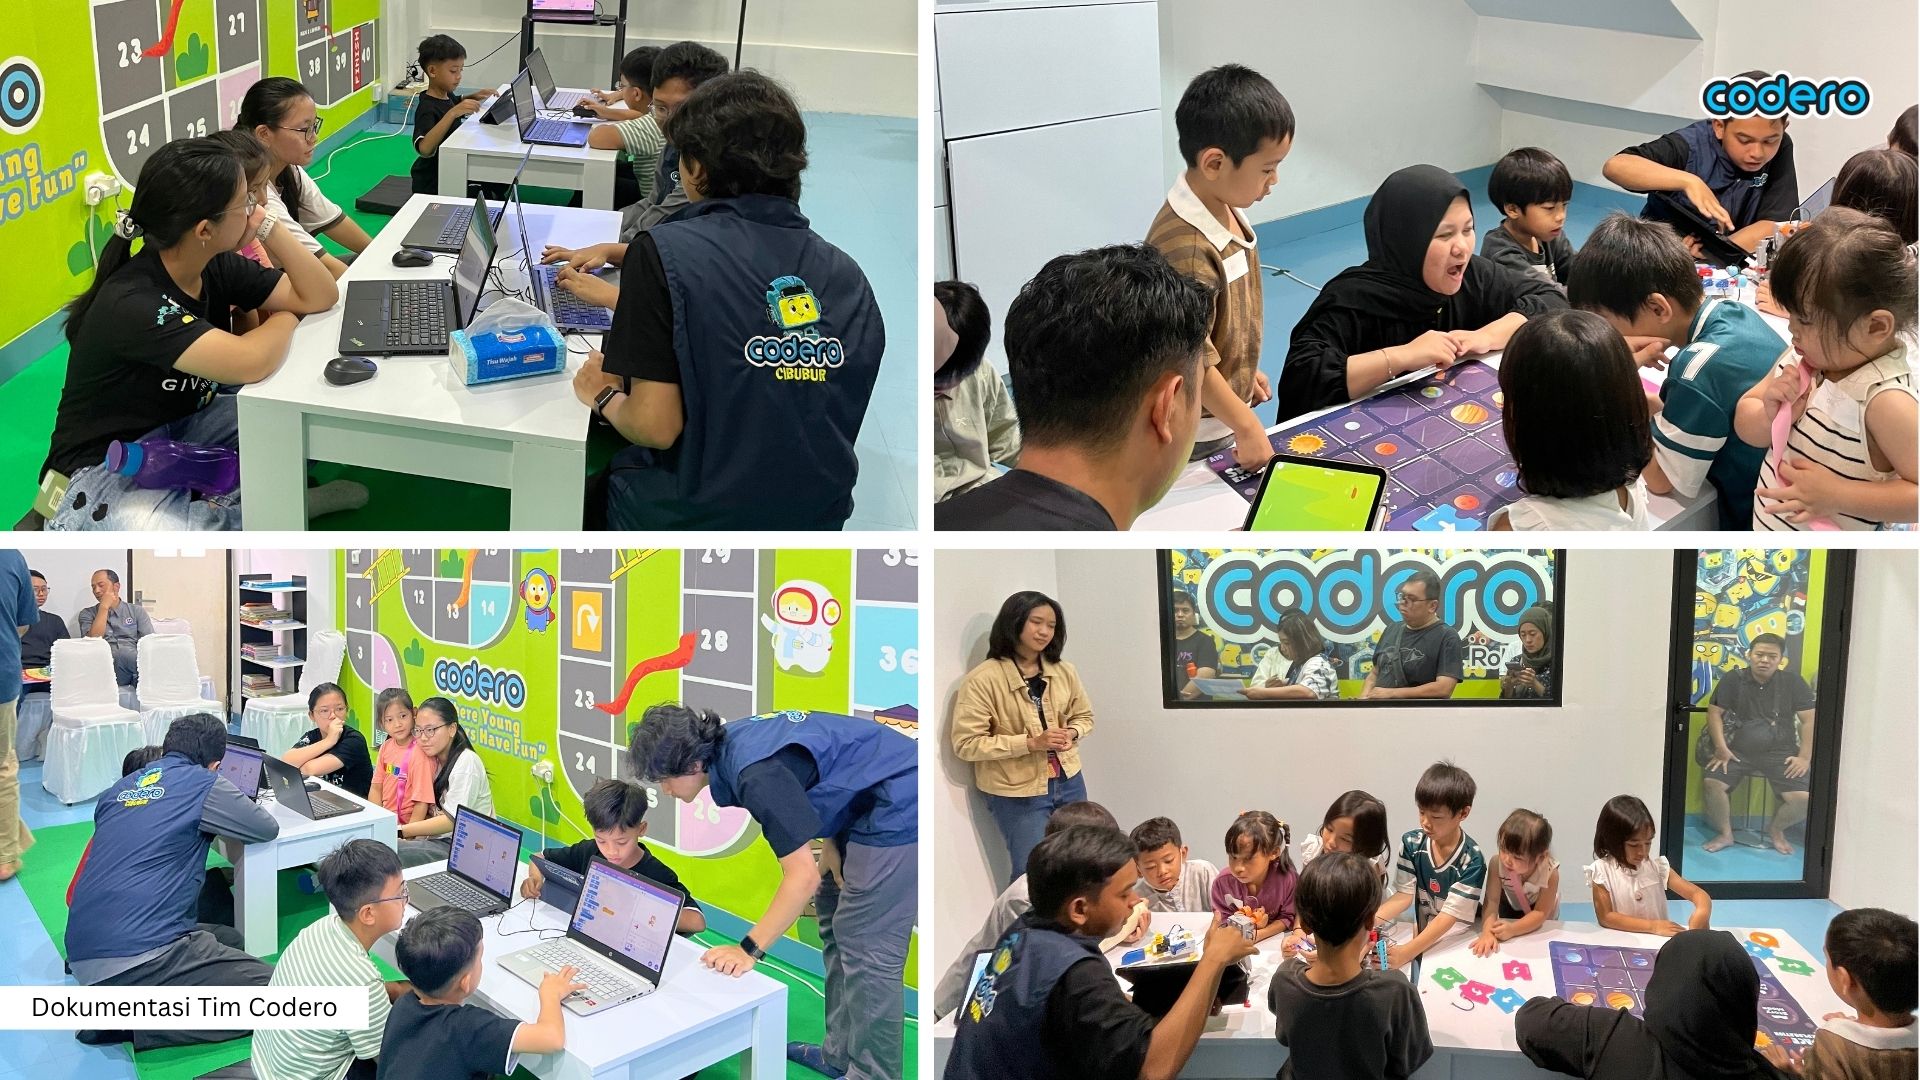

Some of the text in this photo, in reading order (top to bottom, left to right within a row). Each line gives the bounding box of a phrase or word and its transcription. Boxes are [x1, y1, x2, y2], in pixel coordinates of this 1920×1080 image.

[228, 11, 245, 36] 27
[117, 38, 143, 68] 23
[335, 52, 347, 72] 39
[361, 46, 371, 64] 40
[308, 56, 320, 77] 38
[126, 123, 150, 155] 24
[746, 334, 843, 367] codero
[775, 367, 827, 382] CIBUBUR
[356, 595, 362, 609] 4
[413, 588, 425, 605] 12
[481, 599, 495, 617] 14
[446, 603, 460, 620] 13
[700, 628, 729, 652] 28
[357, 645, 363, 660] 3
[879, 644, 918, 675] 36
[434, 658, 526, 710] codero
[574, 688, 595, 710] 23
[481, 708, 520, 738] Young
[480, 728, 511, 752] Have
[575, 751, 596, 775] 24
[694, 797, 721, 825] 26
